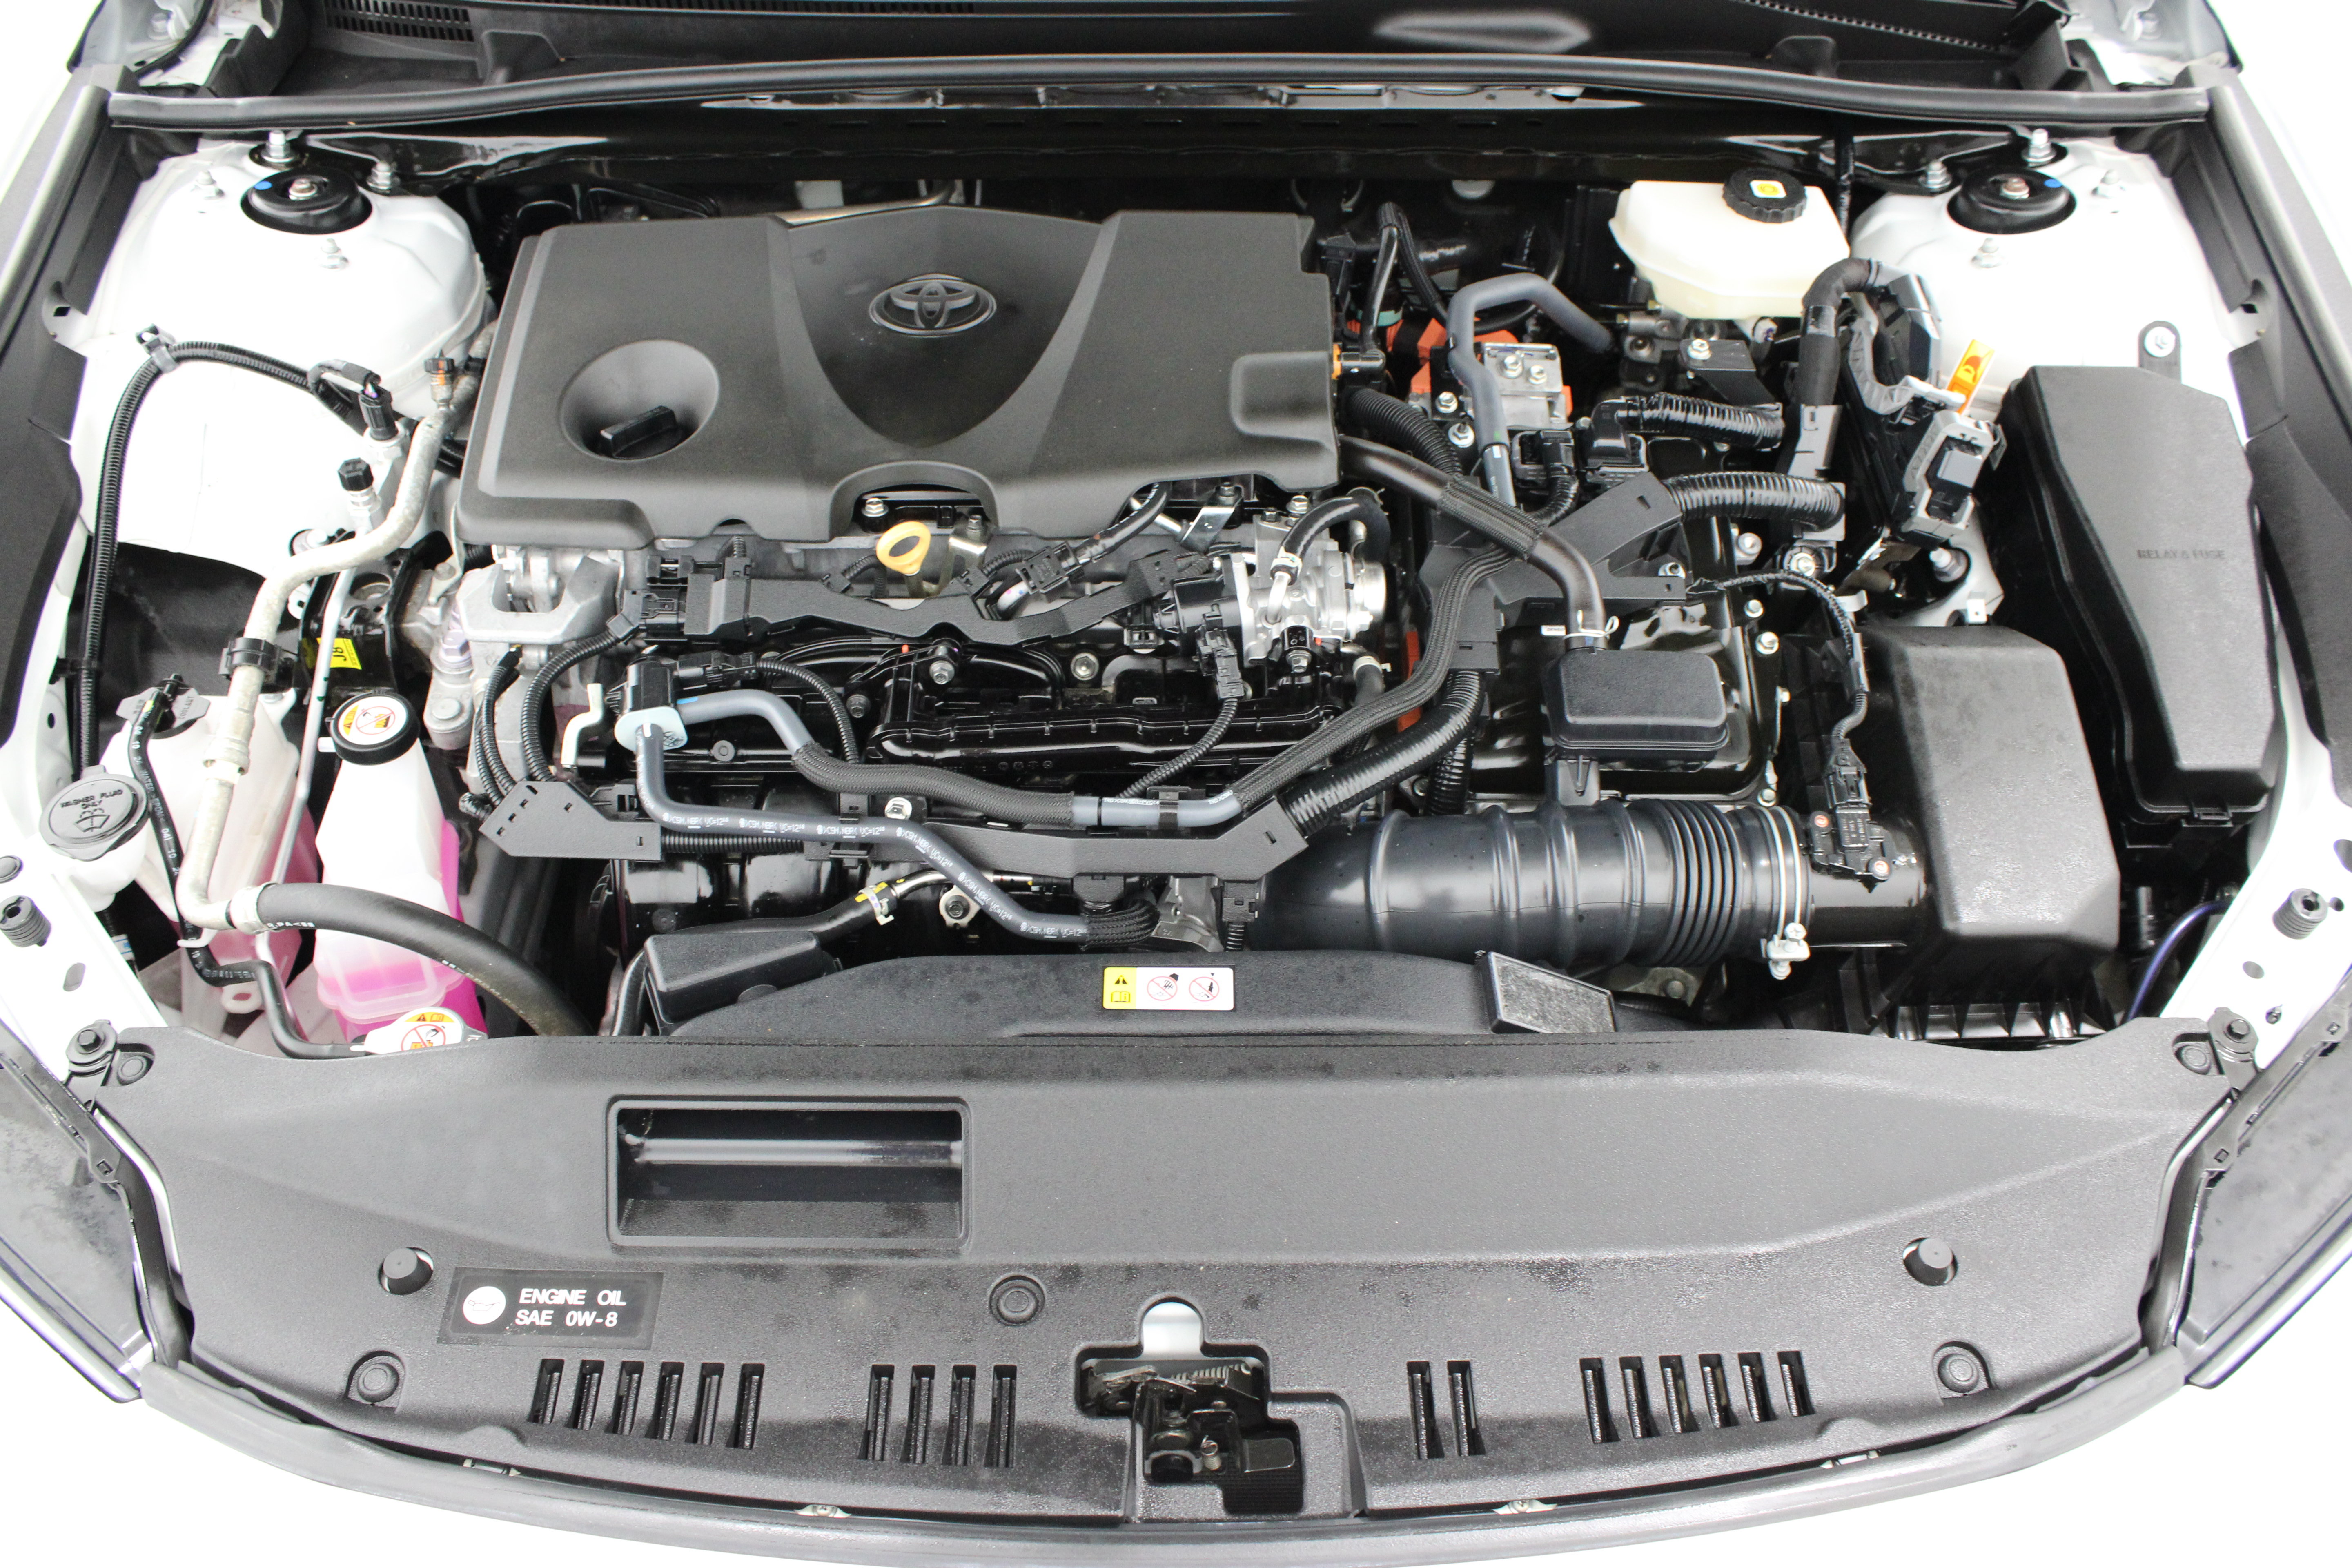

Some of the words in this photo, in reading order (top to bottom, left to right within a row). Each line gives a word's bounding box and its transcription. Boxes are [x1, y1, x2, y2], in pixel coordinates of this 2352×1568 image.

[2137, 549, 2176, 559] RELAY
[2192, 549, 2225, 559] FUSE
[60, 795, 95, 808] WASHER
[100, 789, 123, 798] FLUID
[81, 800, 102, 809] ONLY
[519, 1288, 587, 1305] ENGINE
[597, 1290, 627, 1306] OIL
[514, 1309, 554, 1326] SAE
[565, 1310, 618, 1327] 0W-8
